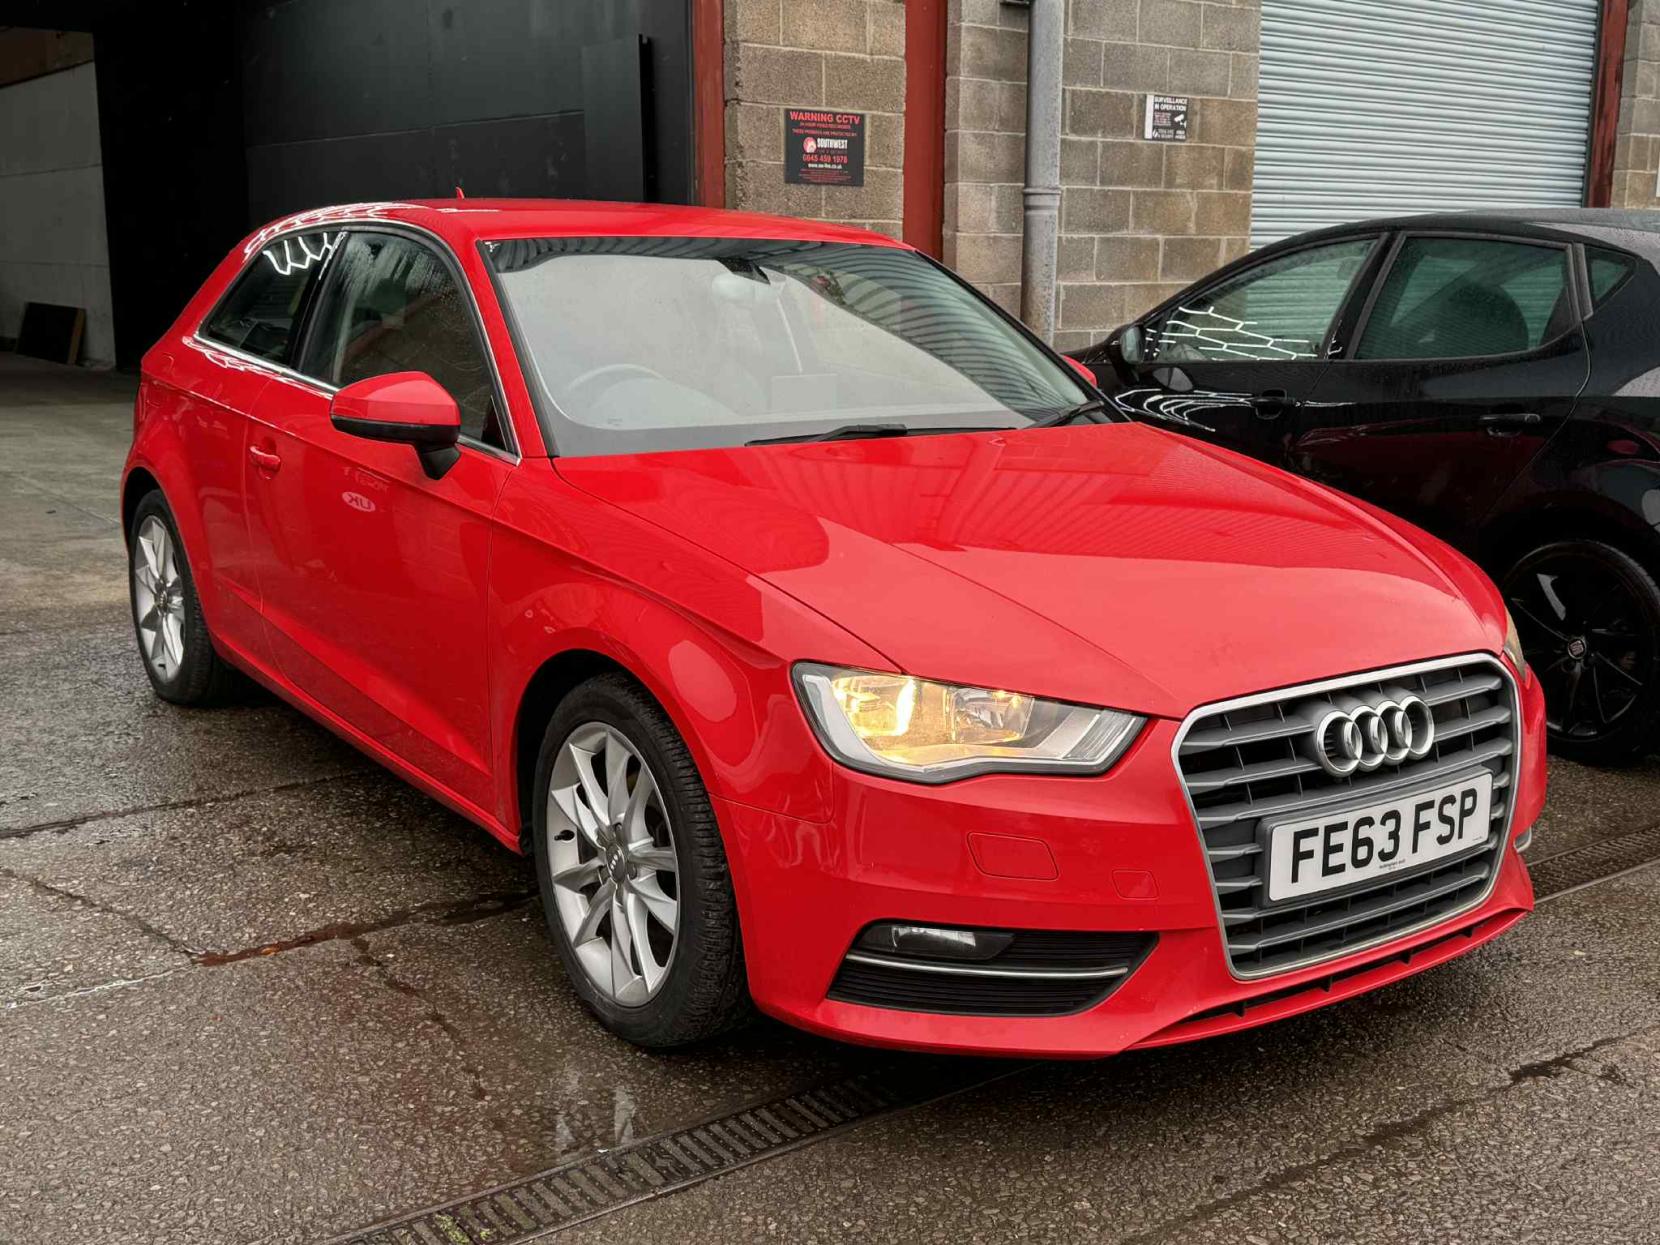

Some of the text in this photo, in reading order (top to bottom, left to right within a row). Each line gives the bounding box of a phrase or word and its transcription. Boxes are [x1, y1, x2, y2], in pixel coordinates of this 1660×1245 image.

[1154, 96, 1188, 105] SURVEILLANCE
[1160, 104, 1187, 112] OPERATION
[790, 111, 860, 125] WARNING CCTV
[817, 138, 848, 149] SOUTHWEST
[1291, 788, 1478, 884] FE63 FSP
